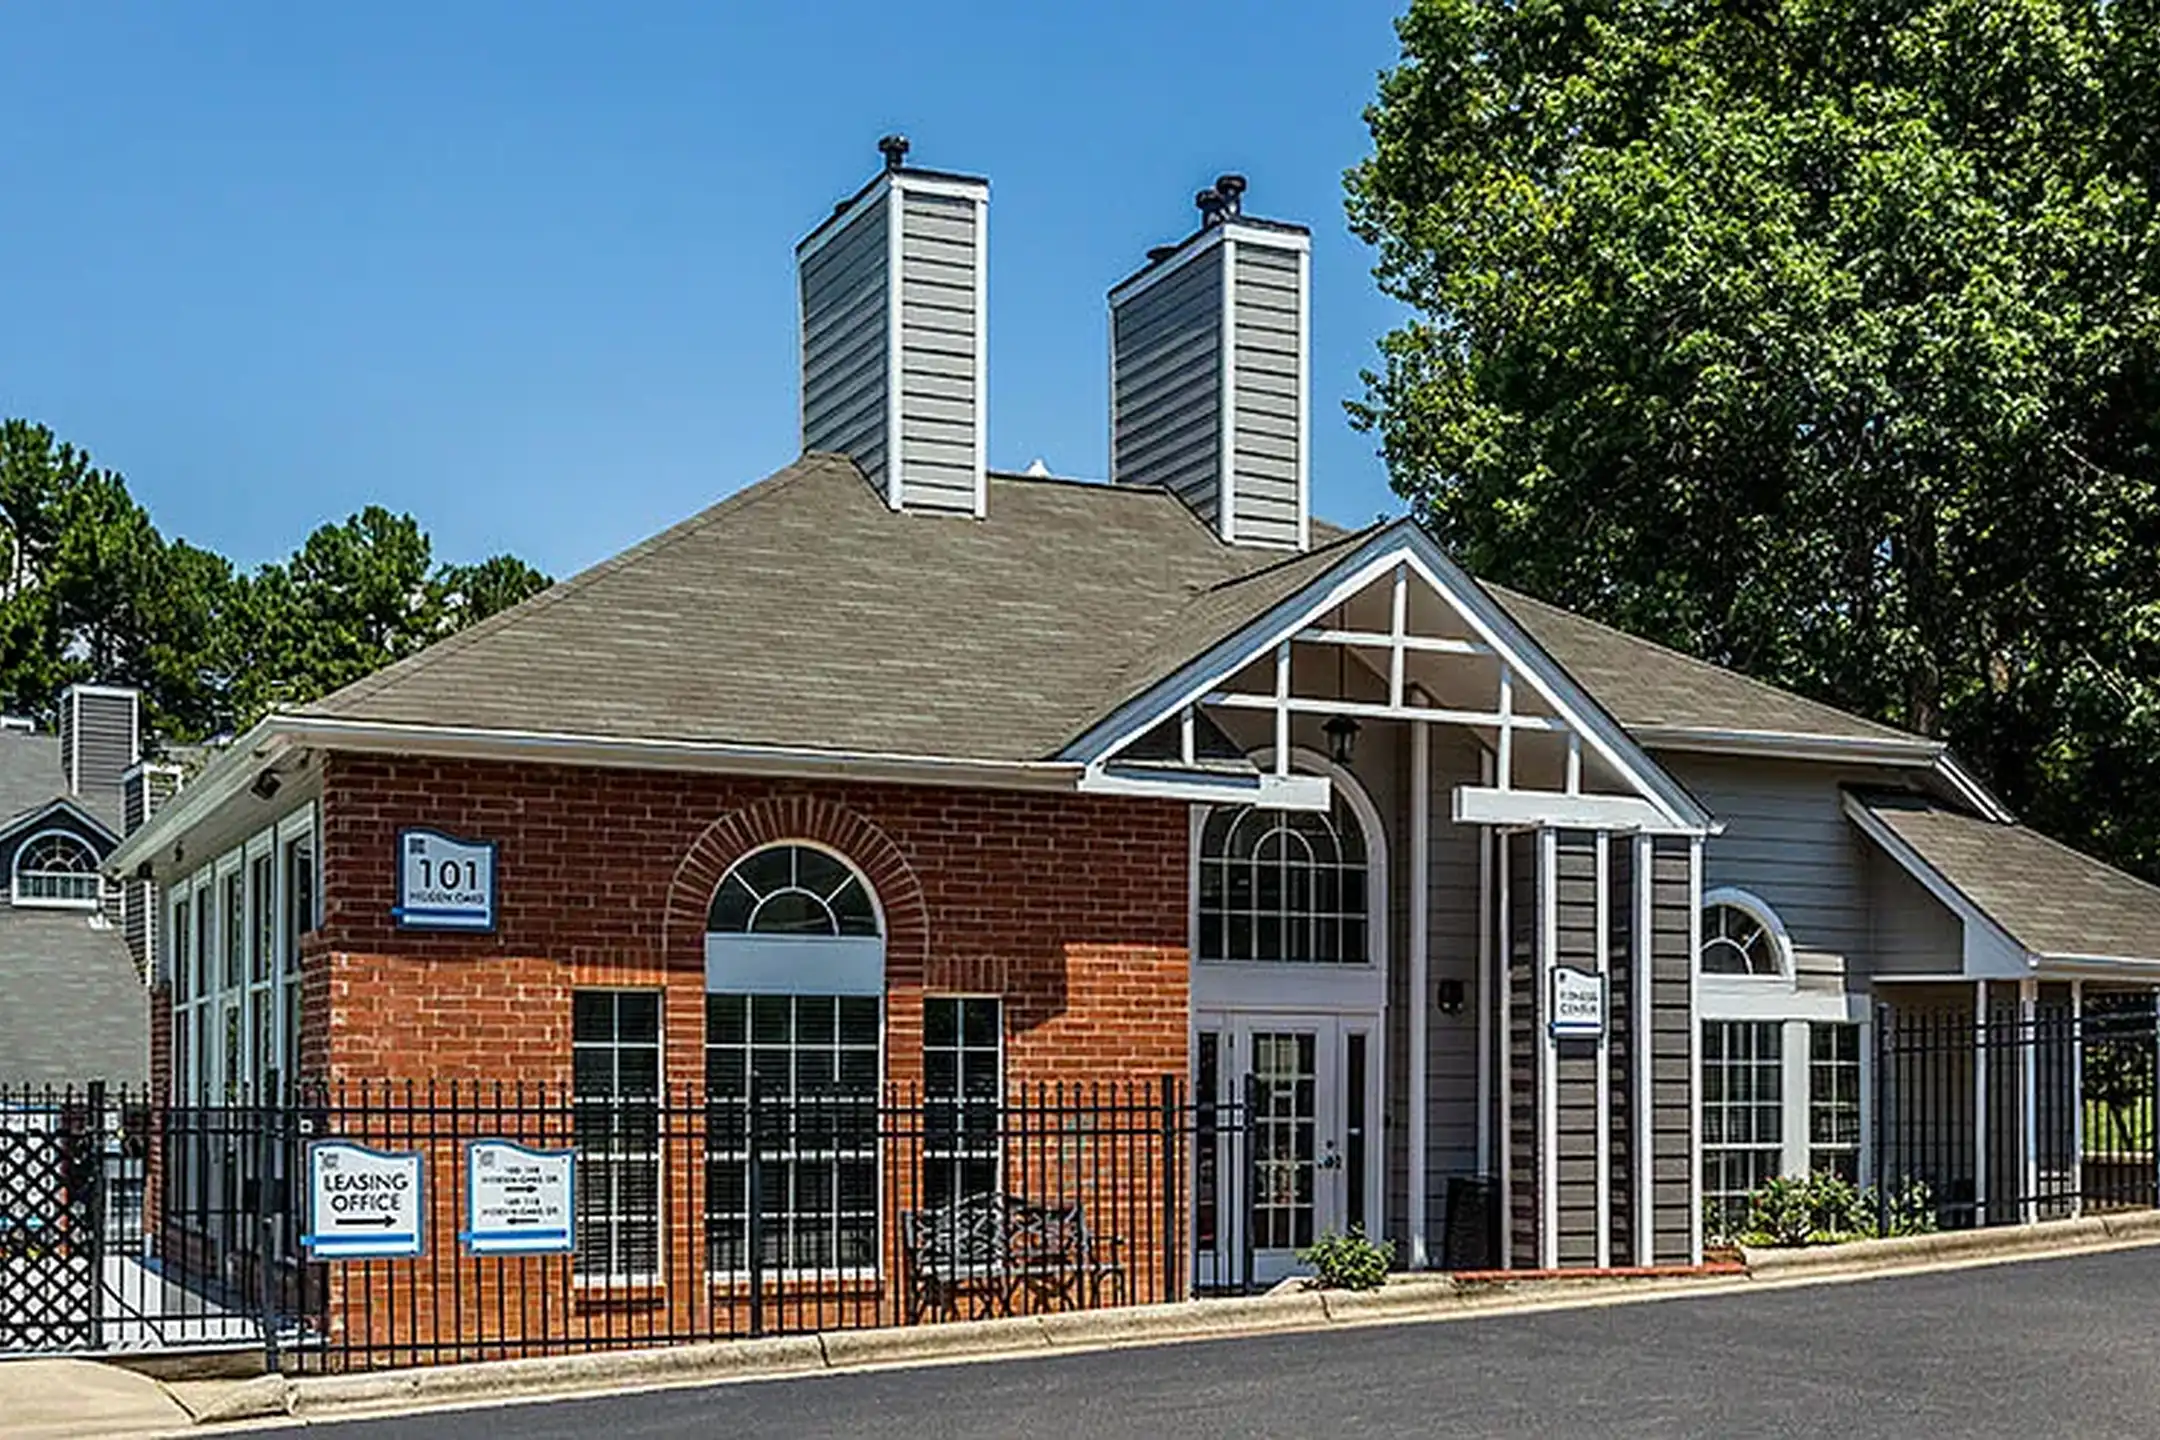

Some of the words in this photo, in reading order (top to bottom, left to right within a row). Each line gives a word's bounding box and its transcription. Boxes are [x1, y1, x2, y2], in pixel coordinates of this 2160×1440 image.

[419, 859, 476, 890] 101
[323, 1173, 409, 1192] LEASING
[331, 1193, 401, 1212] OFFICE
